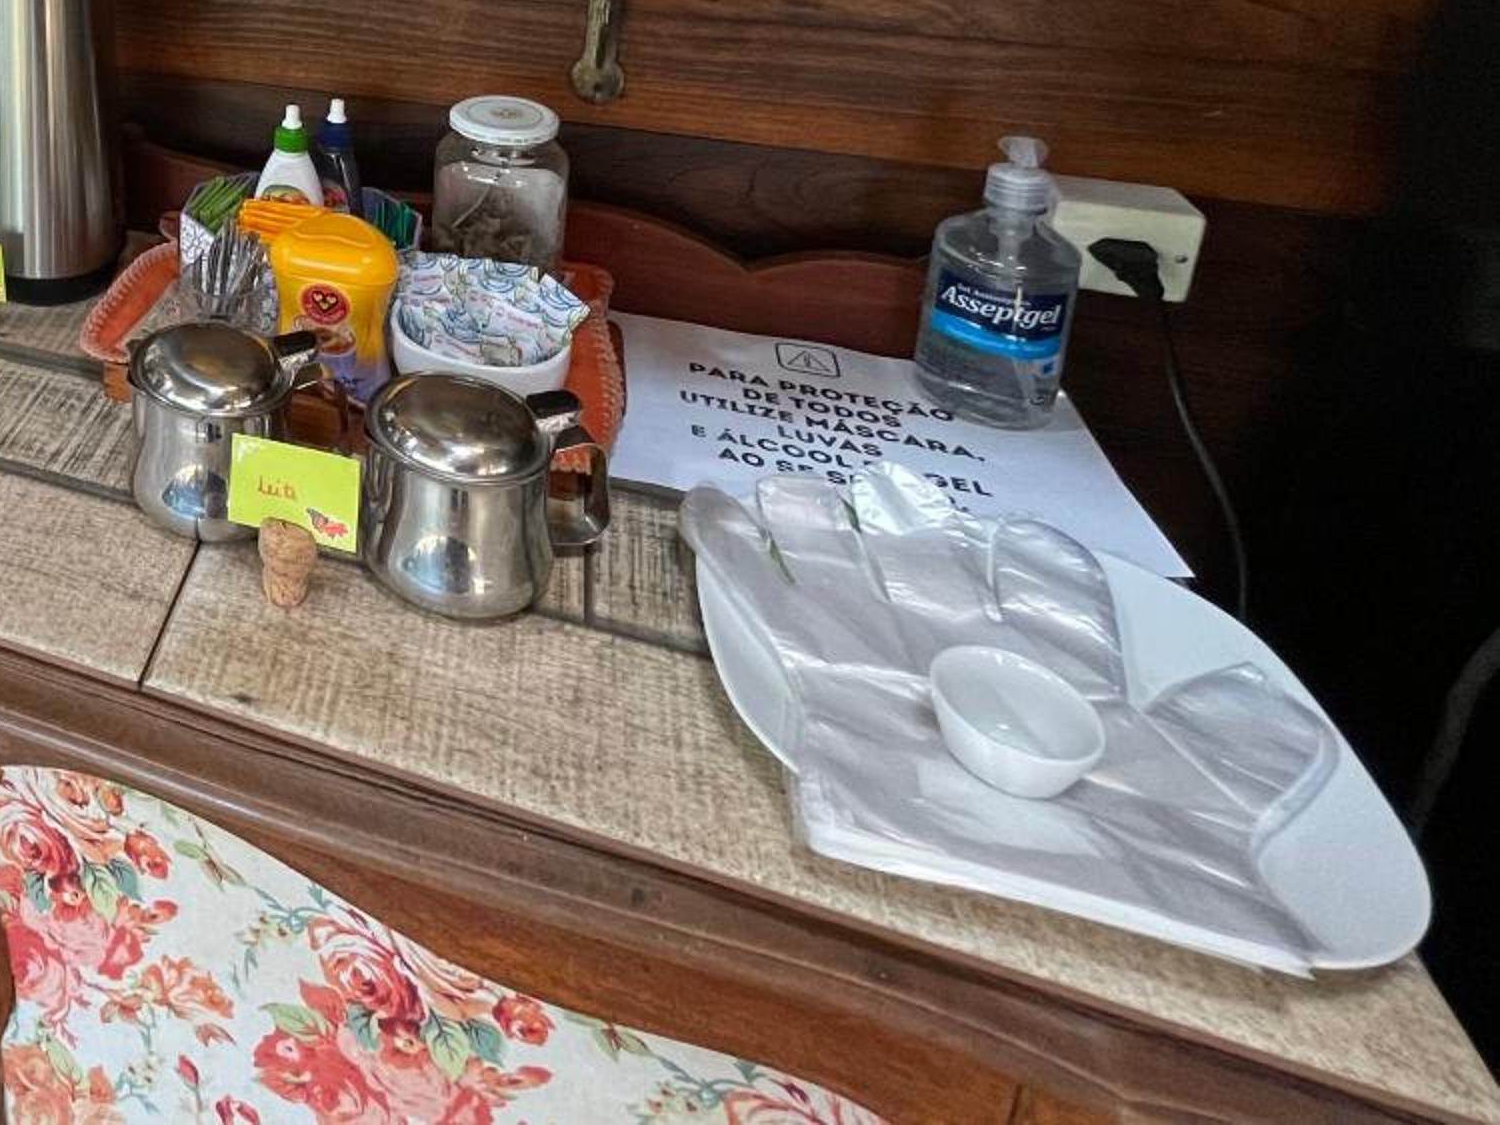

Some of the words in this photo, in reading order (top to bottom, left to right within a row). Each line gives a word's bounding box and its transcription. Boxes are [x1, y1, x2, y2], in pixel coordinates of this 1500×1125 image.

[941, 285, 1062, 329] Asseptgel
[689, 362, 770, 389] PARA
[779, 379, 955, 422] PROTEÇÃO
[742, 387, 780, 405] DE
[788, 396, 902, 428] TODOS
[679, 389, 795, 424] UTILIZE
[804, 416, 987, 461] MÁSCARA,
[691, 425, 706, 438] E
[717, 428, 854, 469] ÁLCOOL
[777, 425, 884, 458] LUVAS
[718, 447, 765, 468] AO
